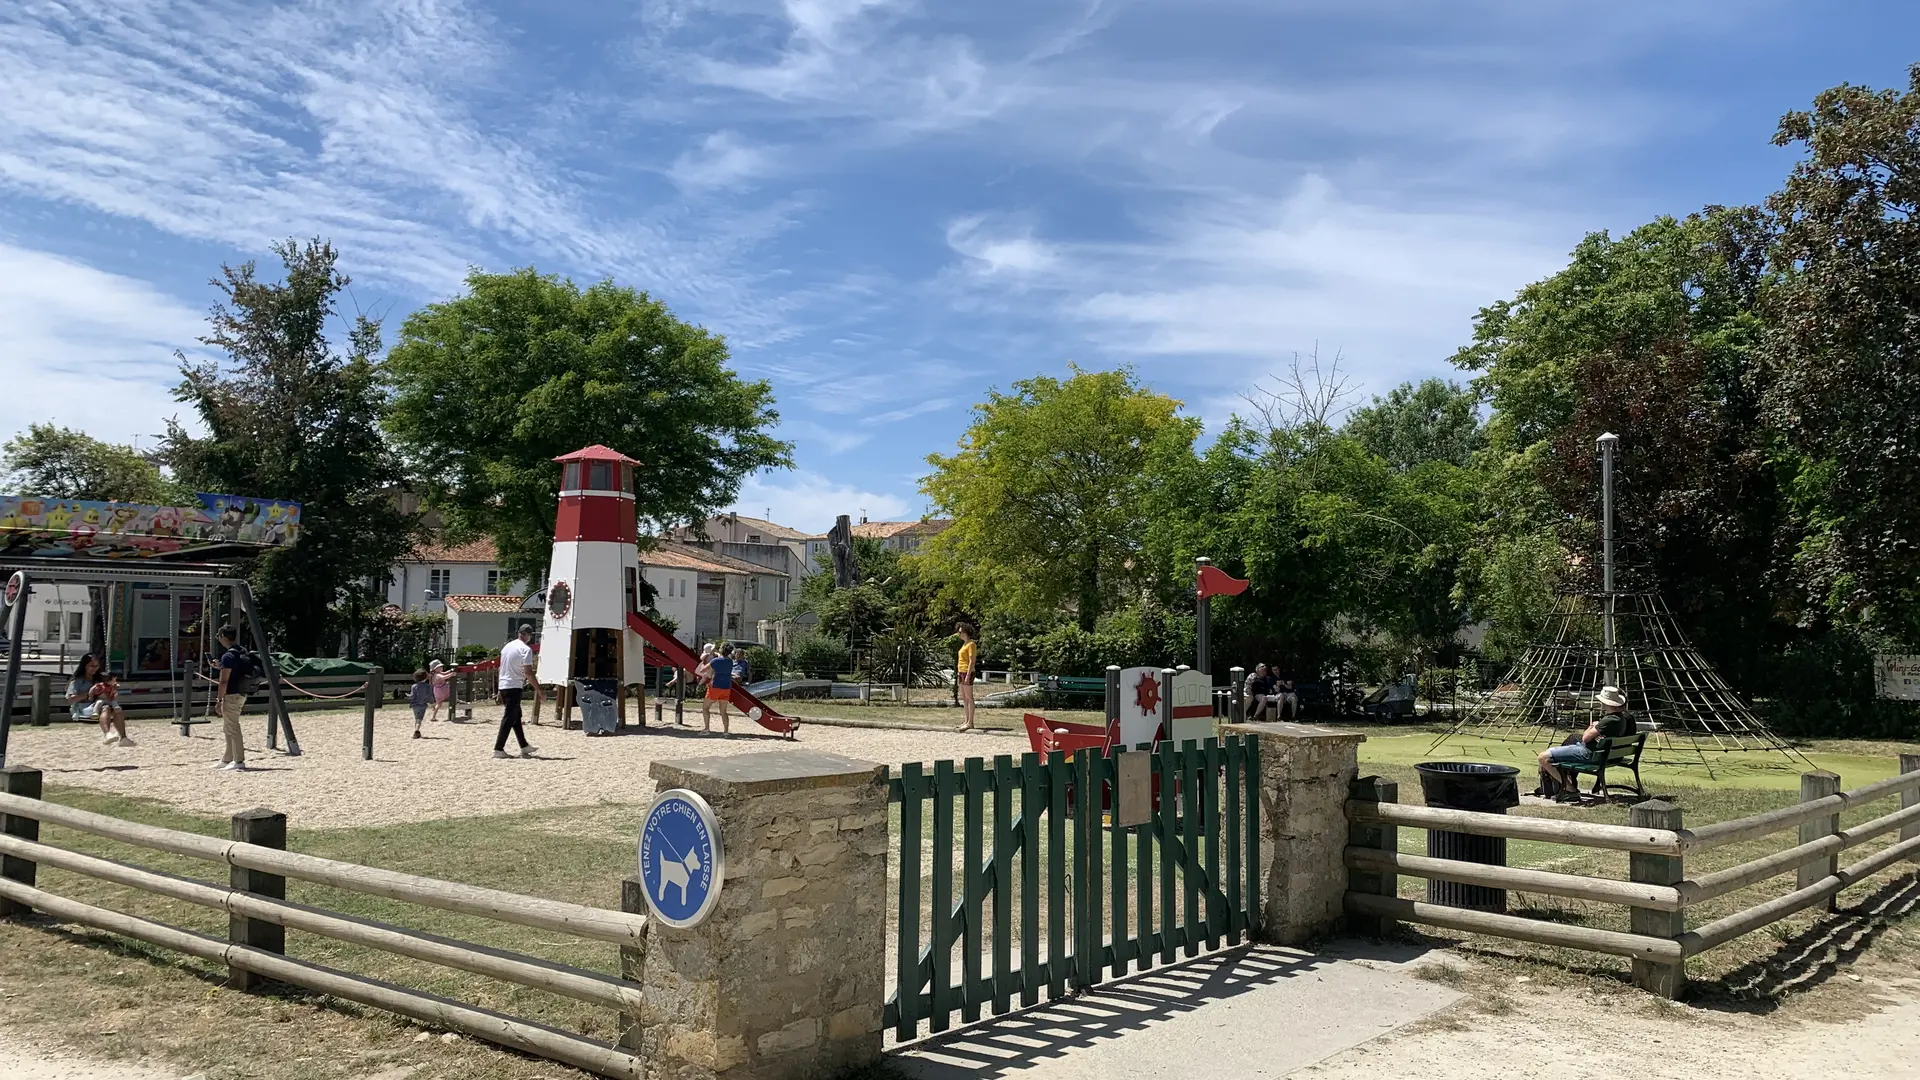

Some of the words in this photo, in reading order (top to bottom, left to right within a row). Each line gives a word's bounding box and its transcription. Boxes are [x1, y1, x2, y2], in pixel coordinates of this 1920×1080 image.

[1886, 660, 1920, 672] Mini-Go
[647, 803, 671, 831] VOTRE
[672, 802, 697, 824] CHIEN
[695, 822, 706, 840] EN
[643, 833, 652, 877] TENEZ
[700, 843, 711, 891] LAISSE
